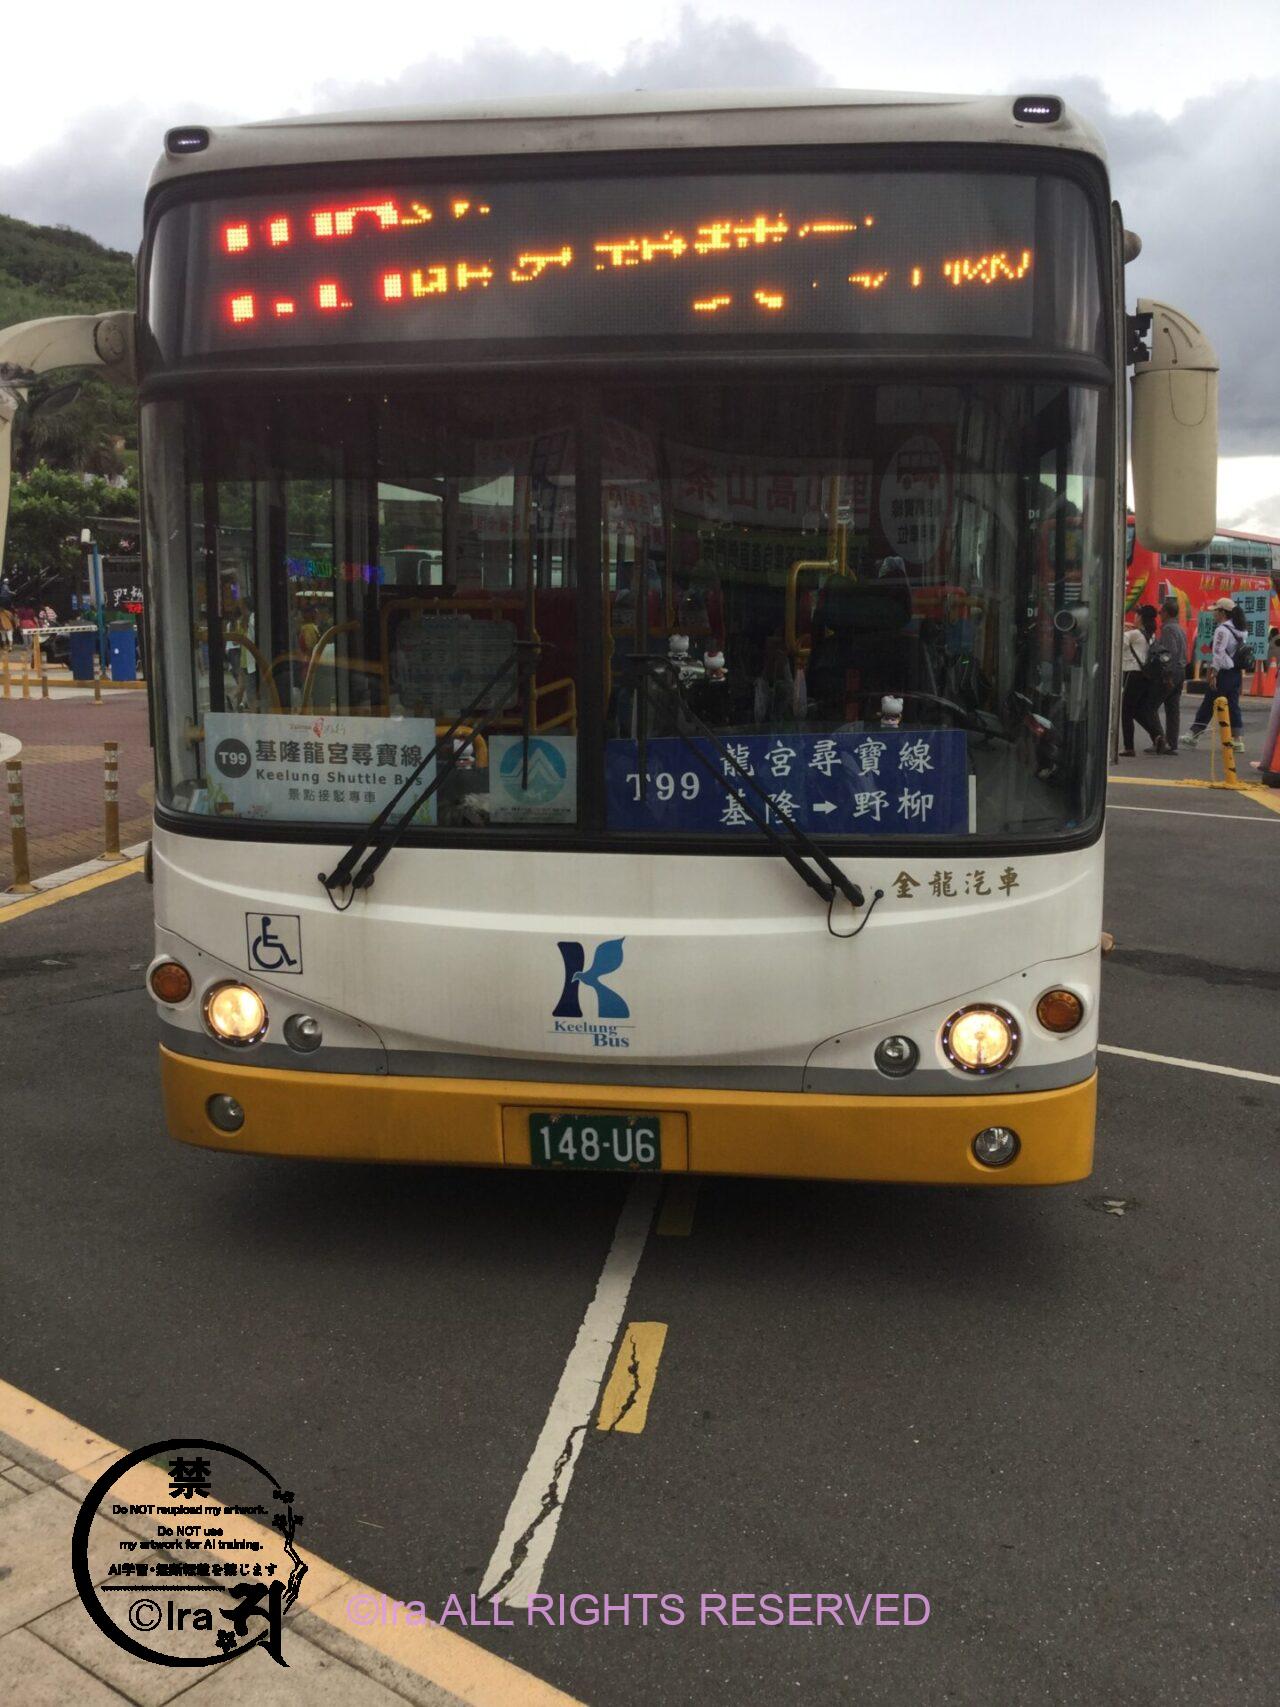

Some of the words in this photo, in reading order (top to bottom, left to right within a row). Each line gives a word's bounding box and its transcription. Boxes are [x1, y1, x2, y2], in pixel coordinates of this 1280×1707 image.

[218, 751, 248, 766] T99
[255, 739, 423, 769] 基隆龍宮尋寶線
[720, 737, 934, 777] 龍宮尋寶線
[256, 768, 320, 785] Keelung
[327, 770, 386, 786] Shuttle
[625, 771, 700, 801] T99
[287, 787, 377, 805] 景點接駁專車
[853, 787, 934, 823] 野柳
[891, 866, 1020, 899] 金龍汽車
[554, 1020, 617, 1036] Keelung
[592, 1033, 630, 1048] Bus
[539, 1126, 656, 1164] 148-U6
